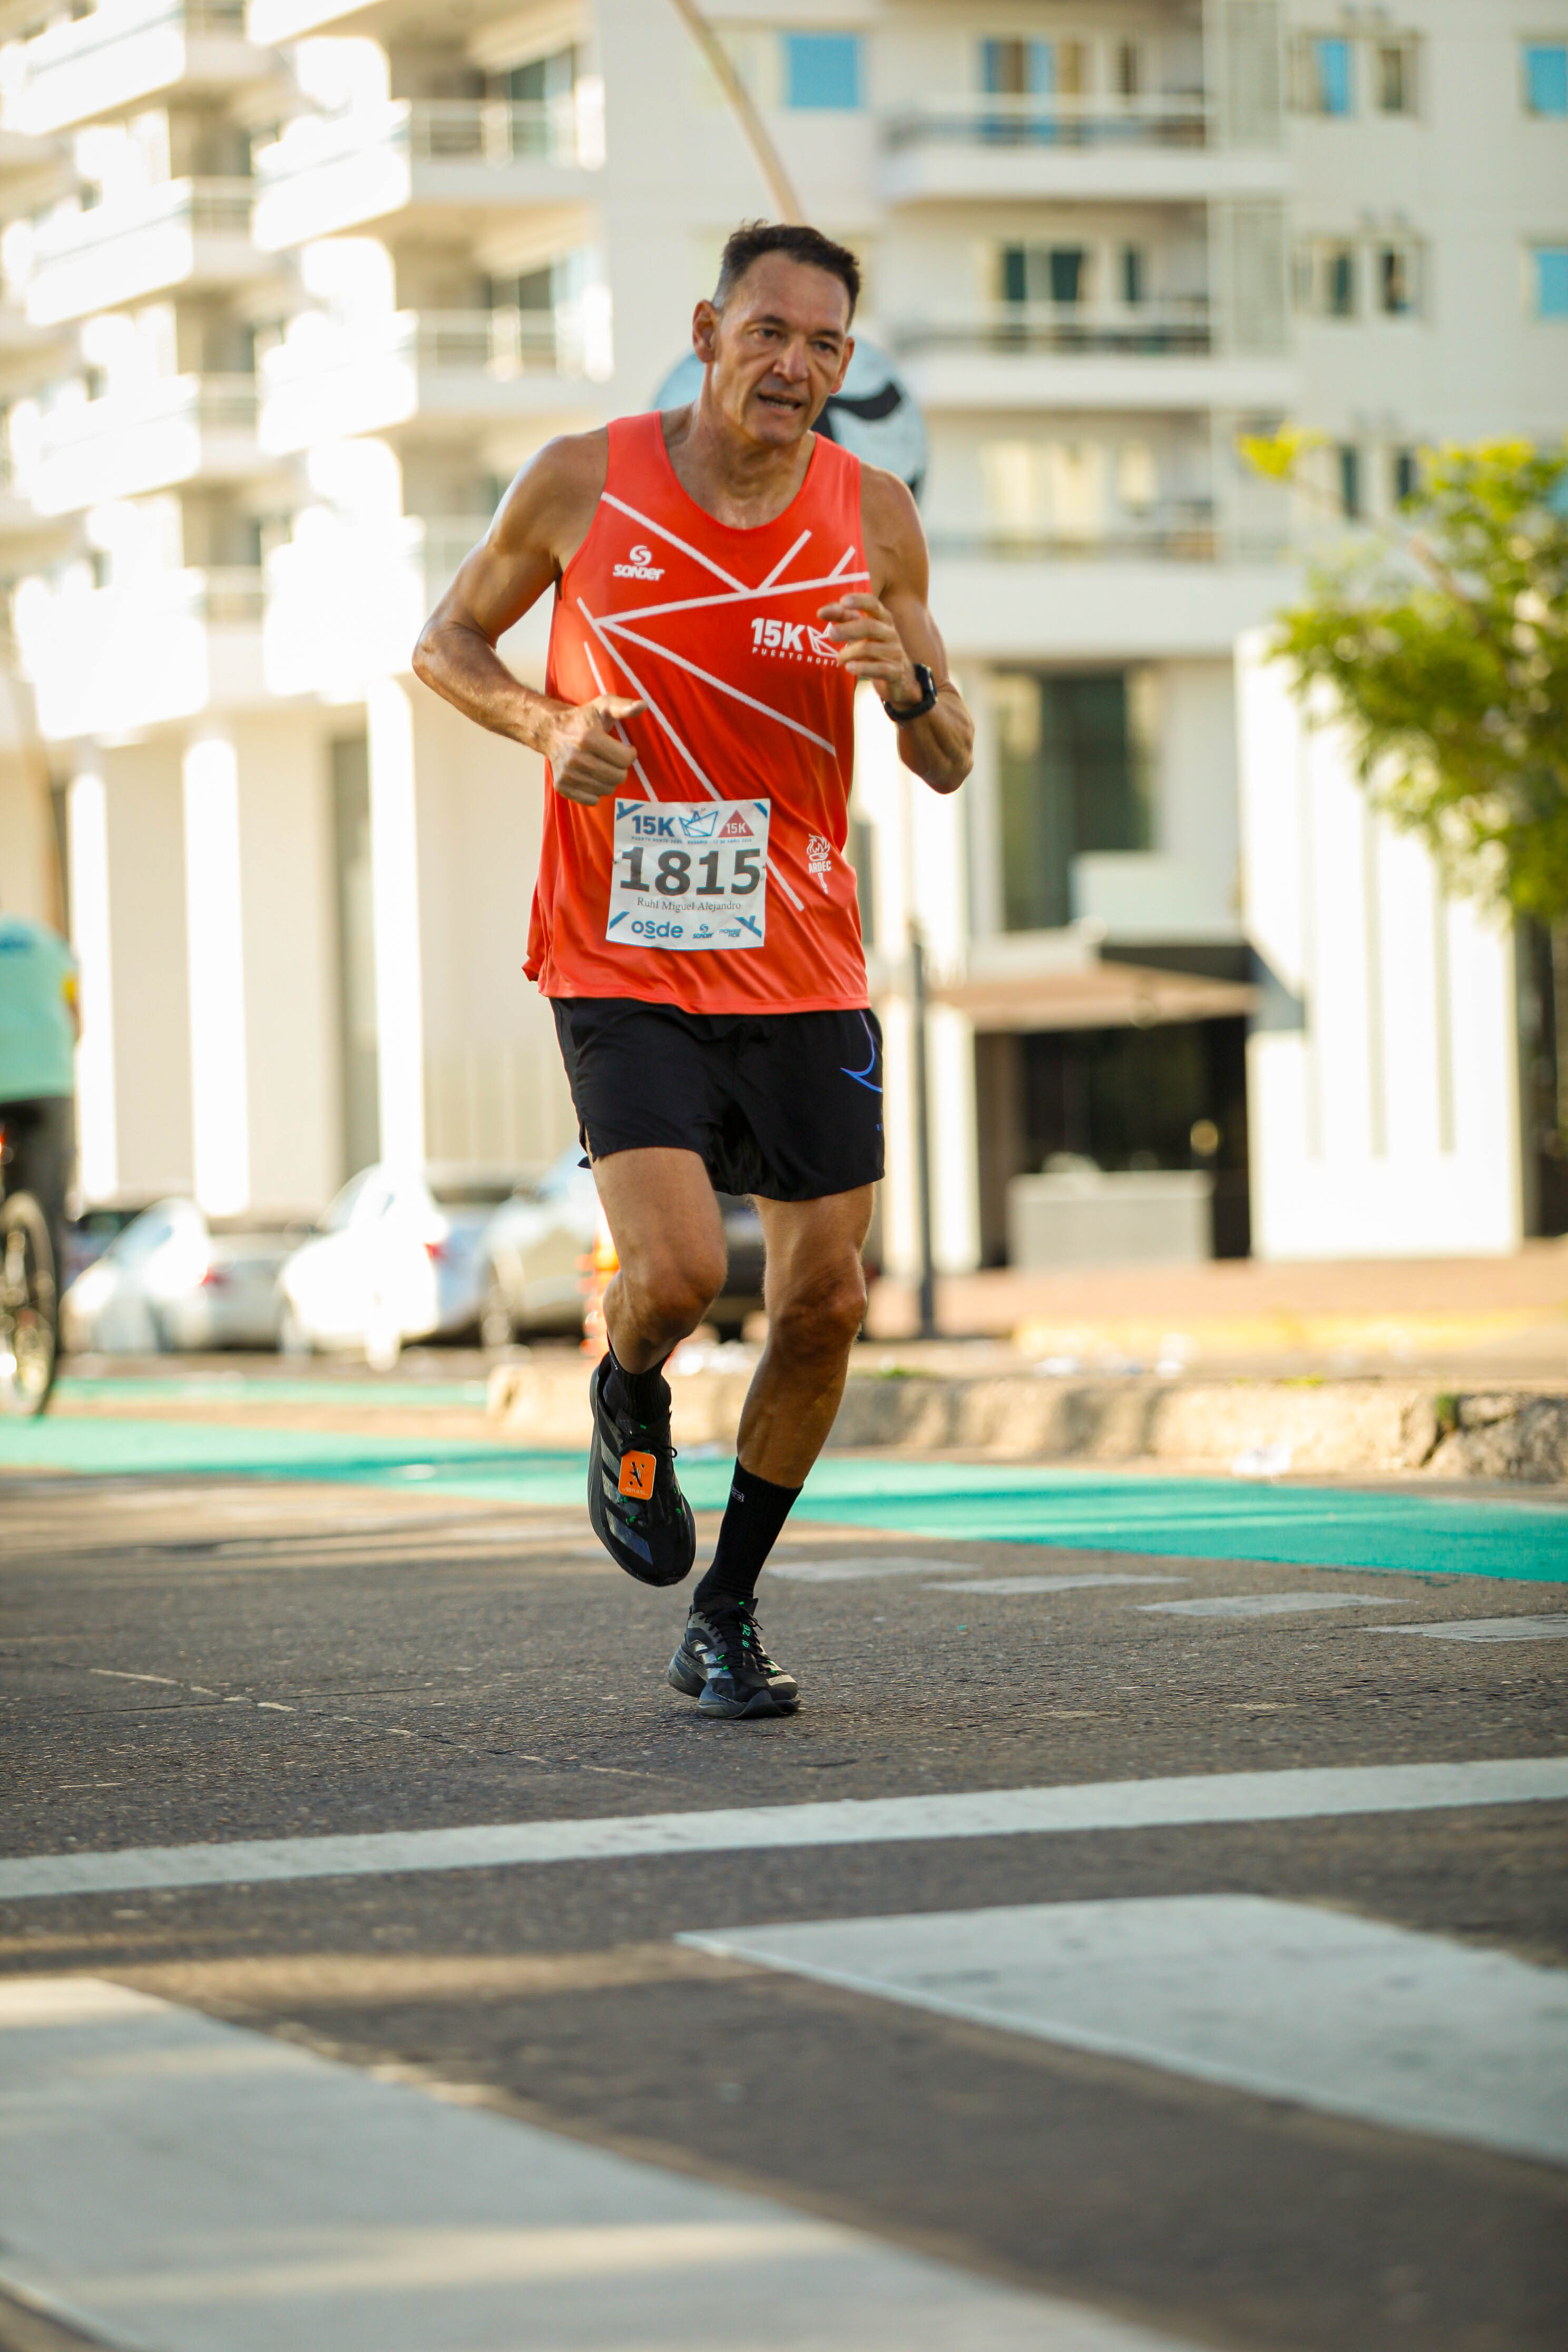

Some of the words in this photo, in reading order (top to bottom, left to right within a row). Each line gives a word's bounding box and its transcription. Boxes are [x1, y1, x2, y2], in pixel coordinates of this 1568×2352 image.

[751, 618, 805, 651] 15K
[752, 647, 803, 661] PUERTO
[807, 656, 839, 668] NORT
[632, 815, 674, 837] 15K
[725, 822, 747, 834] 15K
[620, 846, 761, 896] 1815
[808, 860, 831, 873] ARDEC
[637, 897, 659, 909] Ruhl
[662, 901, 695, 913] Miguel
[698, 899, 741, 912] Alejandro
[631, 920, 683, 938] osde
